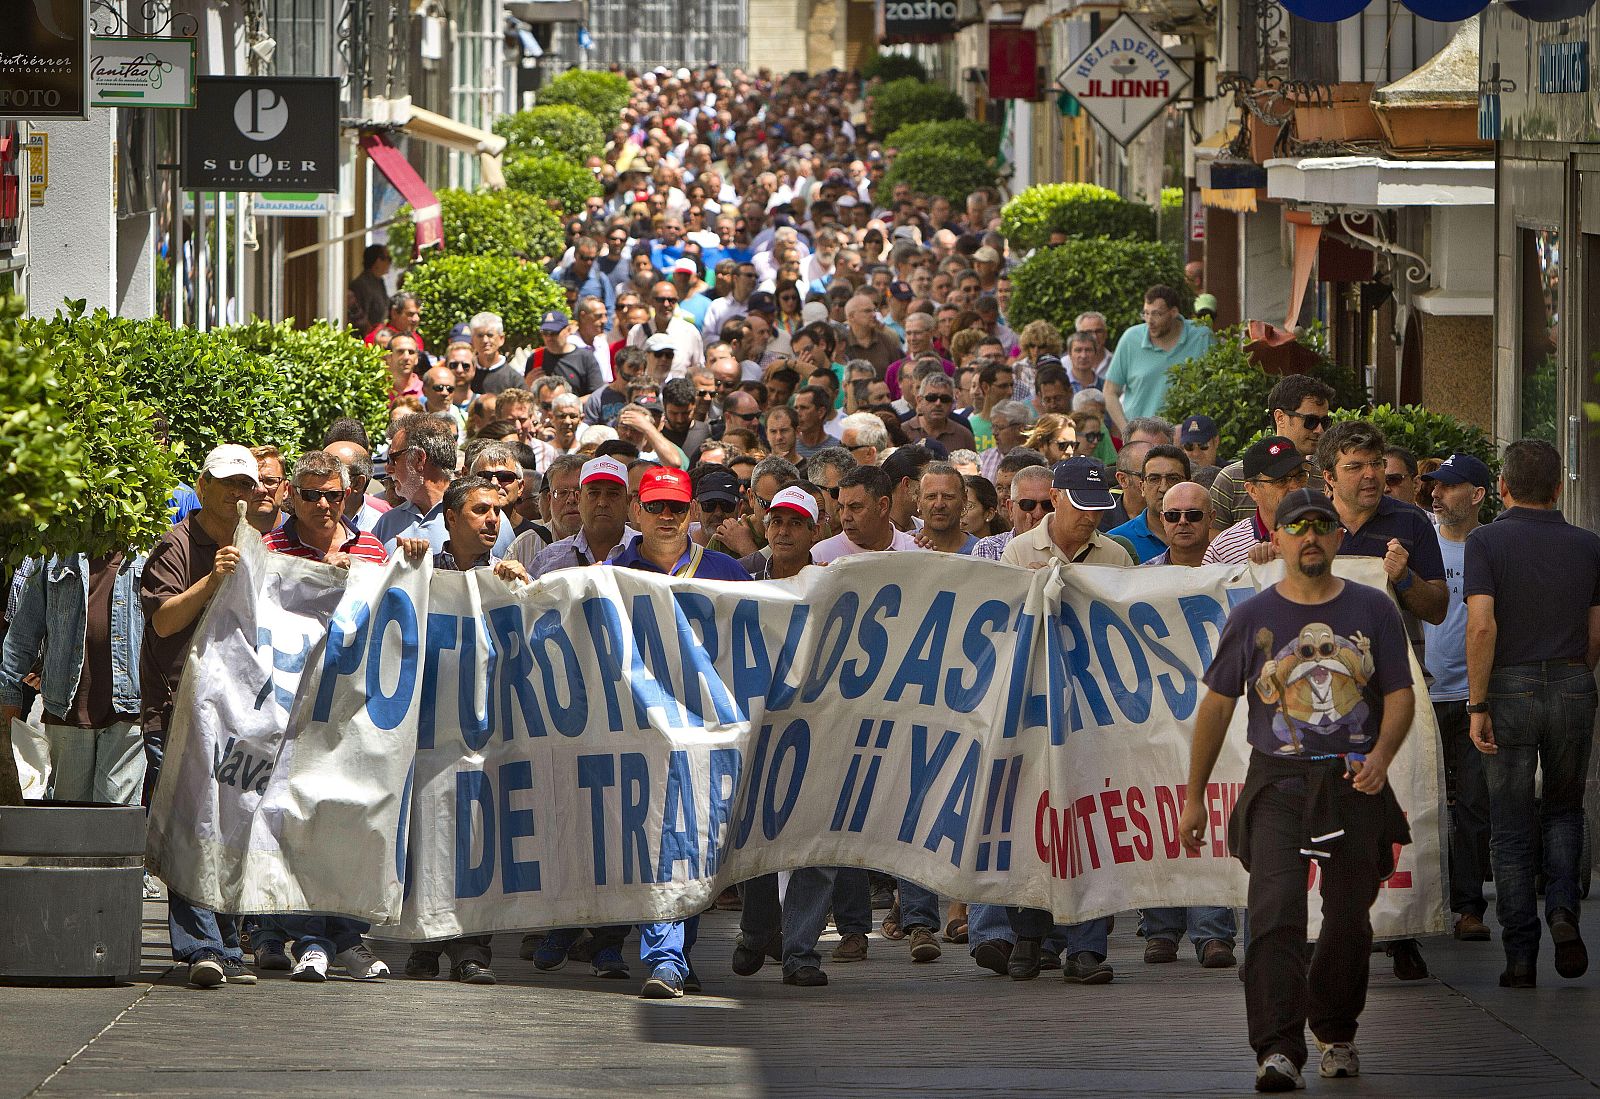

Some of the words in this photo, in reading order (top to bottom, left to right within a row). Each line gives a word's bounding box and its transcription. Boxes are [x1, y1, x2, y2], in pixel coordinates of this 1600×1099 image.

[1077, 37, 1170, 79] HELADERIA
[0, 89, 60, 107] FOTO
[1078, 79, 1169, 98] JIJONA
[203, 153, 317, 178] SUPER
[253, 202, 326, 210] PARAFARMACIA
[455, 760, 542, 899] DE
[577, 719, 811, 886] TRABJO
